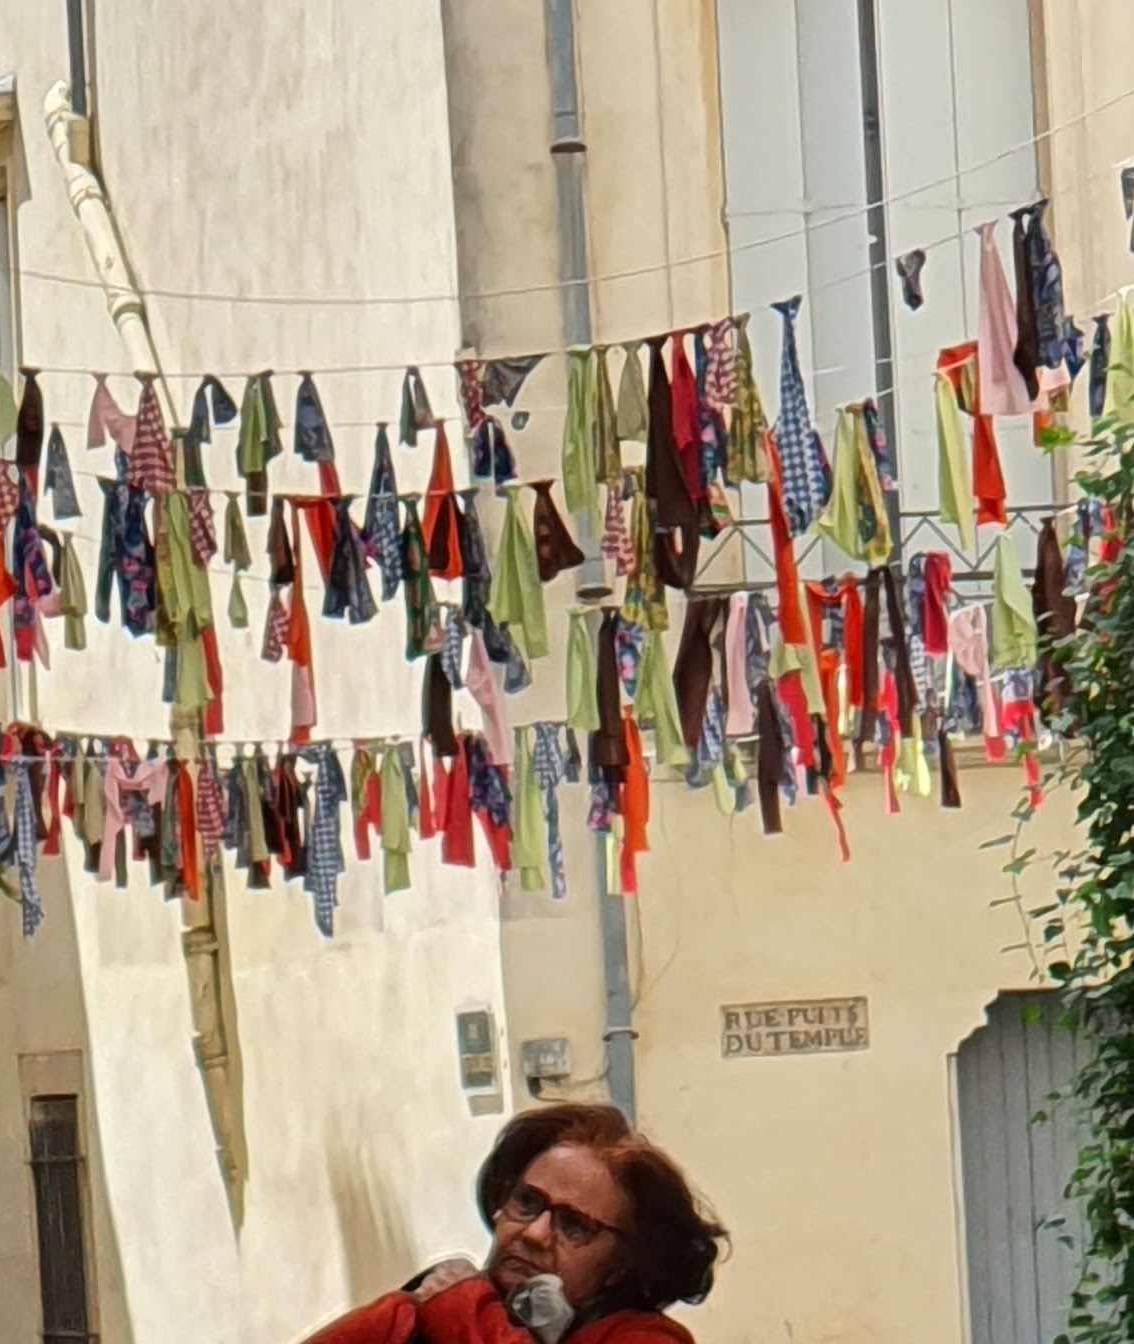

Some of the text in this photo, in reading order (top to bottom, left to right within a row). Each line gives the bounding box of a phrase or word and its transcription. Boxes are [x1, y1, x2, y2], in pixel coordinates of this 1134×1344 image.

[724, 1004, 859, 1031] RUE PUITS
[725, 1027, 868, 1055] DU TEMPLE
